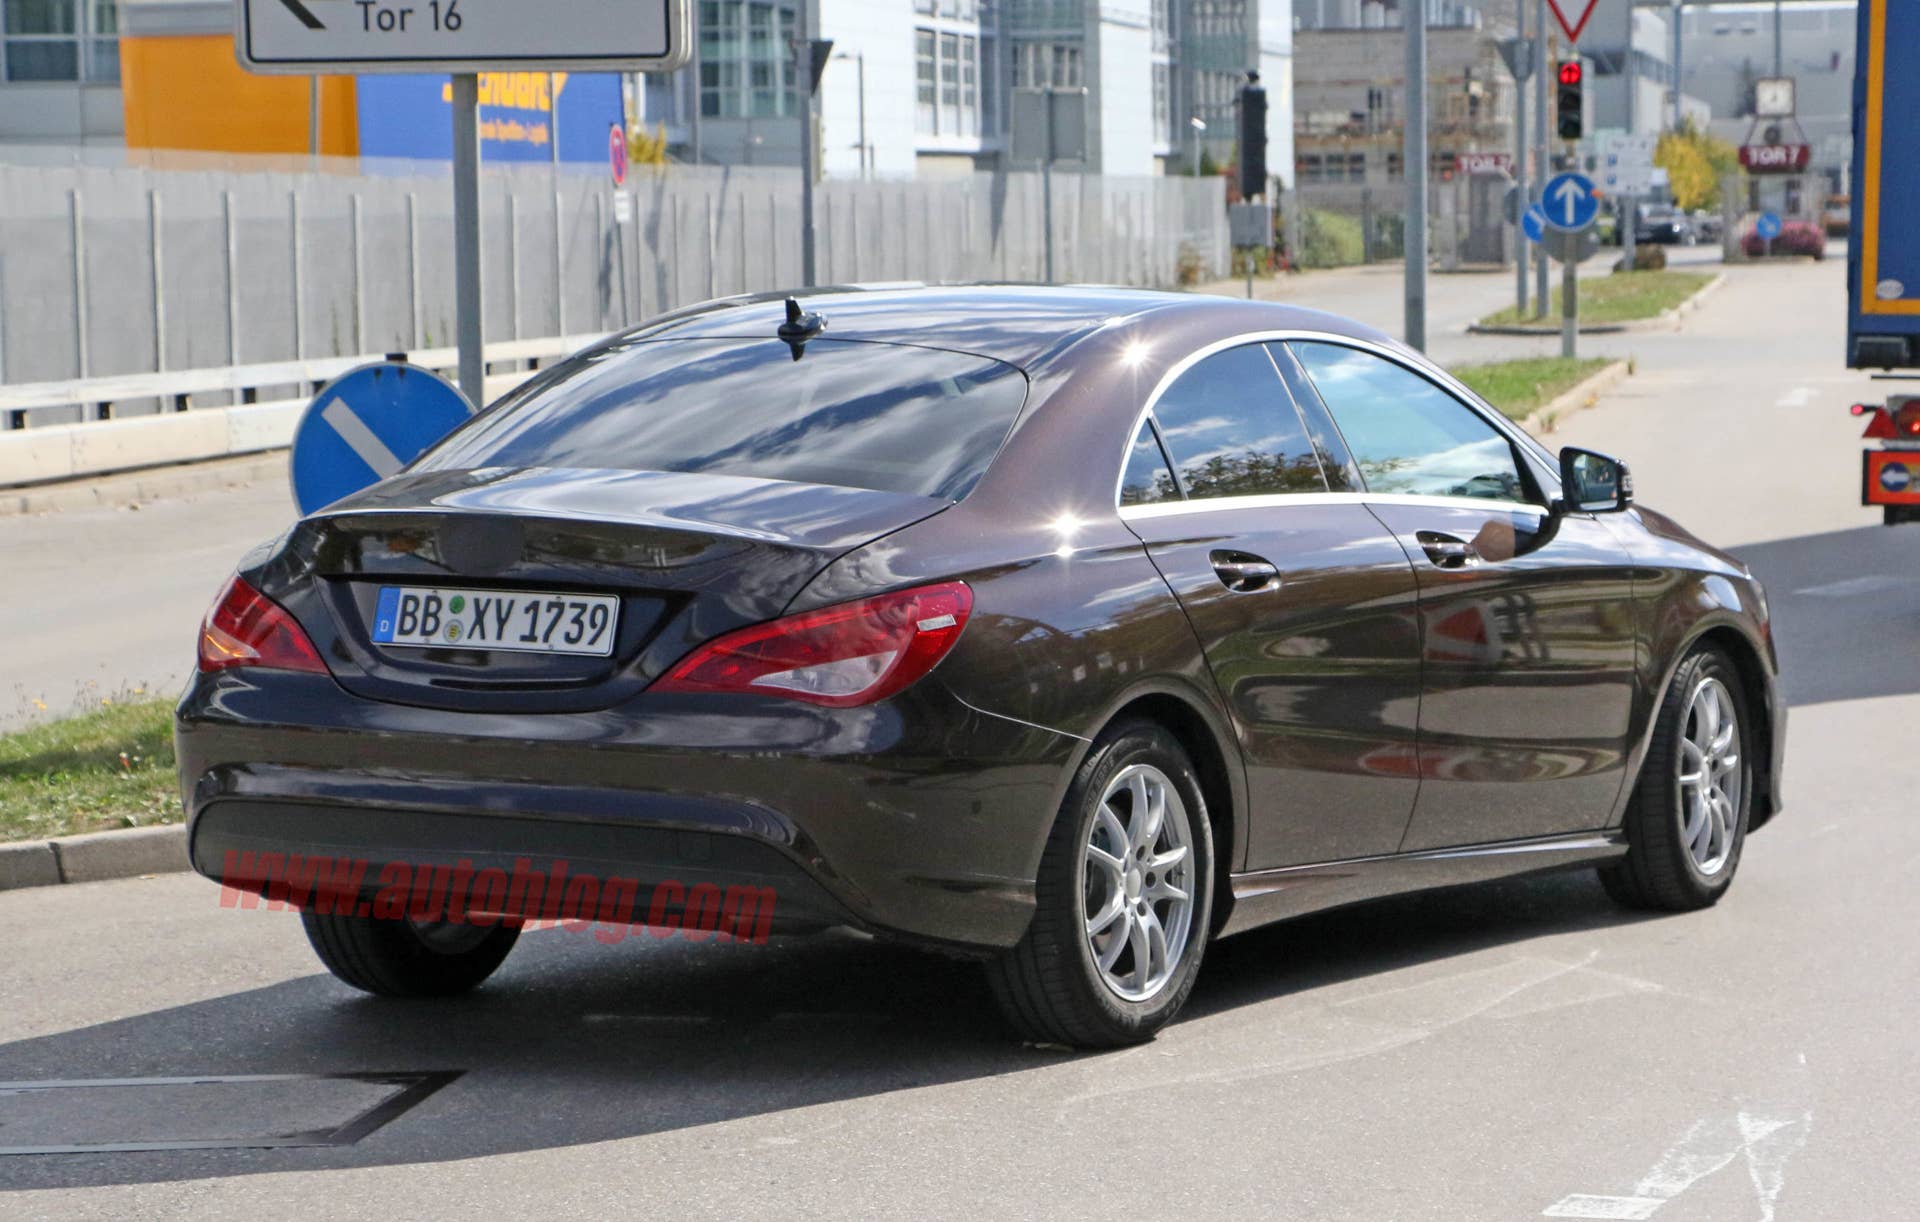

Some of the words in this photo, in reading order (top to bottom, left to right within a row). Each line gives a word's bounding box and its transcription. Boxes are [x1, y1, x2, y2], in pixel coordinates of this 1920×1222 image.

[355, 0, 413, 32] Tor
[429, 0, 462, 31] 16
[1748, 145, 1786, 165] TOR
[1788, 145, 1799, 165] 7
[397, 594, 442, 637] BB
[467, 597, 515, 641] XY
[519, 600, 609, 646] 1739
